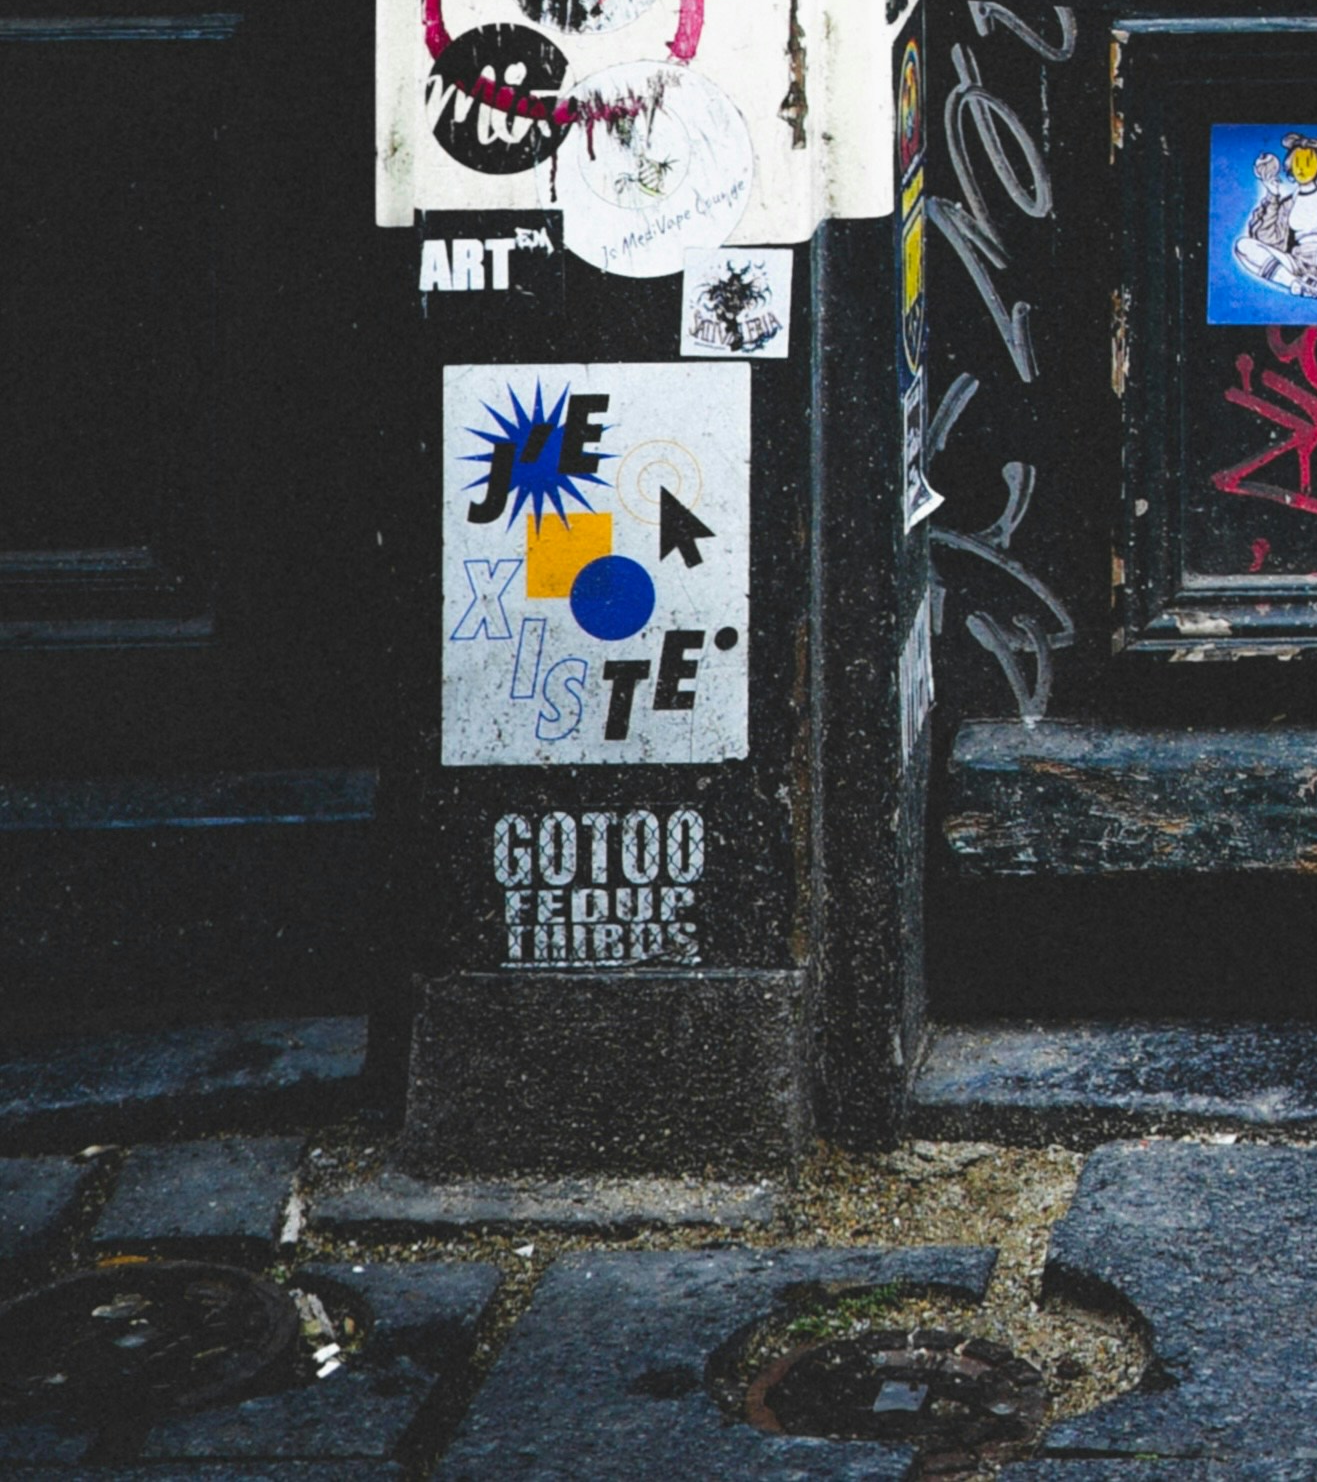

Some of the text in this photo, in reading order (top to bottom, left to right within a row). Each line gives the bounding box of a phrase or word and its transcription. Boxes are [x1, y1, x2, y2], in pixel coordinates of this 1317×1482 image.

[419, 238, 514, 292] ART
[493, 810, 705, 888] GOTOO
[504, 887, 696, 924] FEDUP
